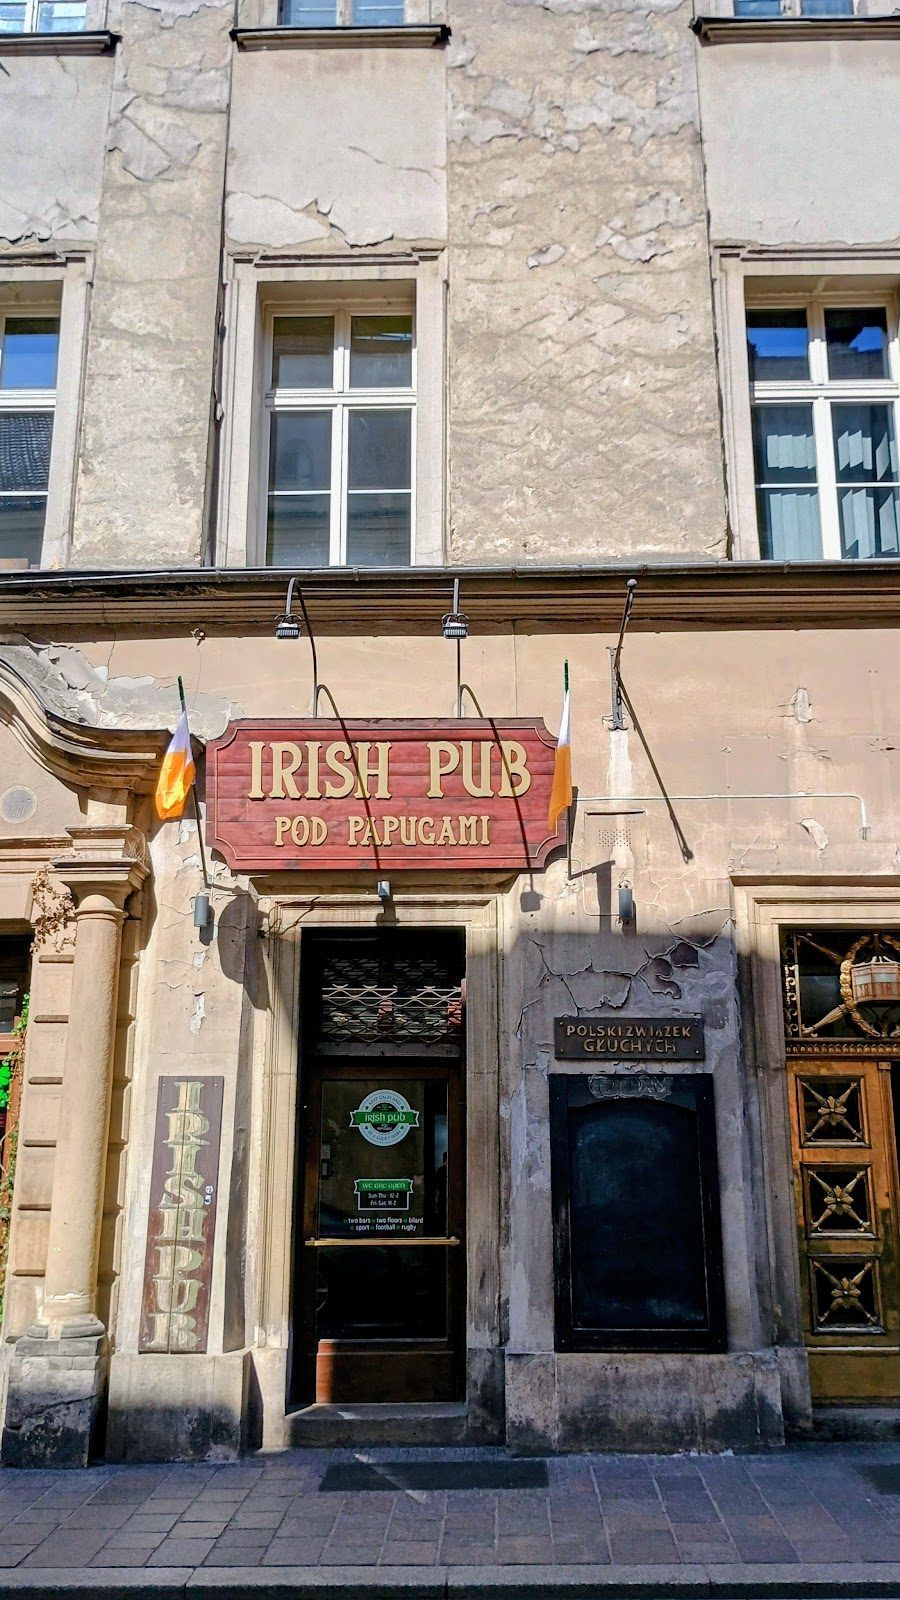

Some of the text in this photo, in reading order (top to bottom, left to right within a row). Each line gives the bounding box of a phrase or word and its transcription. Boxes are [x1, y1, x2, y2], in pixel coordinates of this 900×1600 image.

[247, 740, 532, 800] IRISH PUB
[274, 815, 491, 847] POD PAPUGAMI
[566, 1025, 622, 1038] POLSKI
[387, 1112, 406, 1123] pub
[145, 1081, 211, 1349] IRISH PUB
